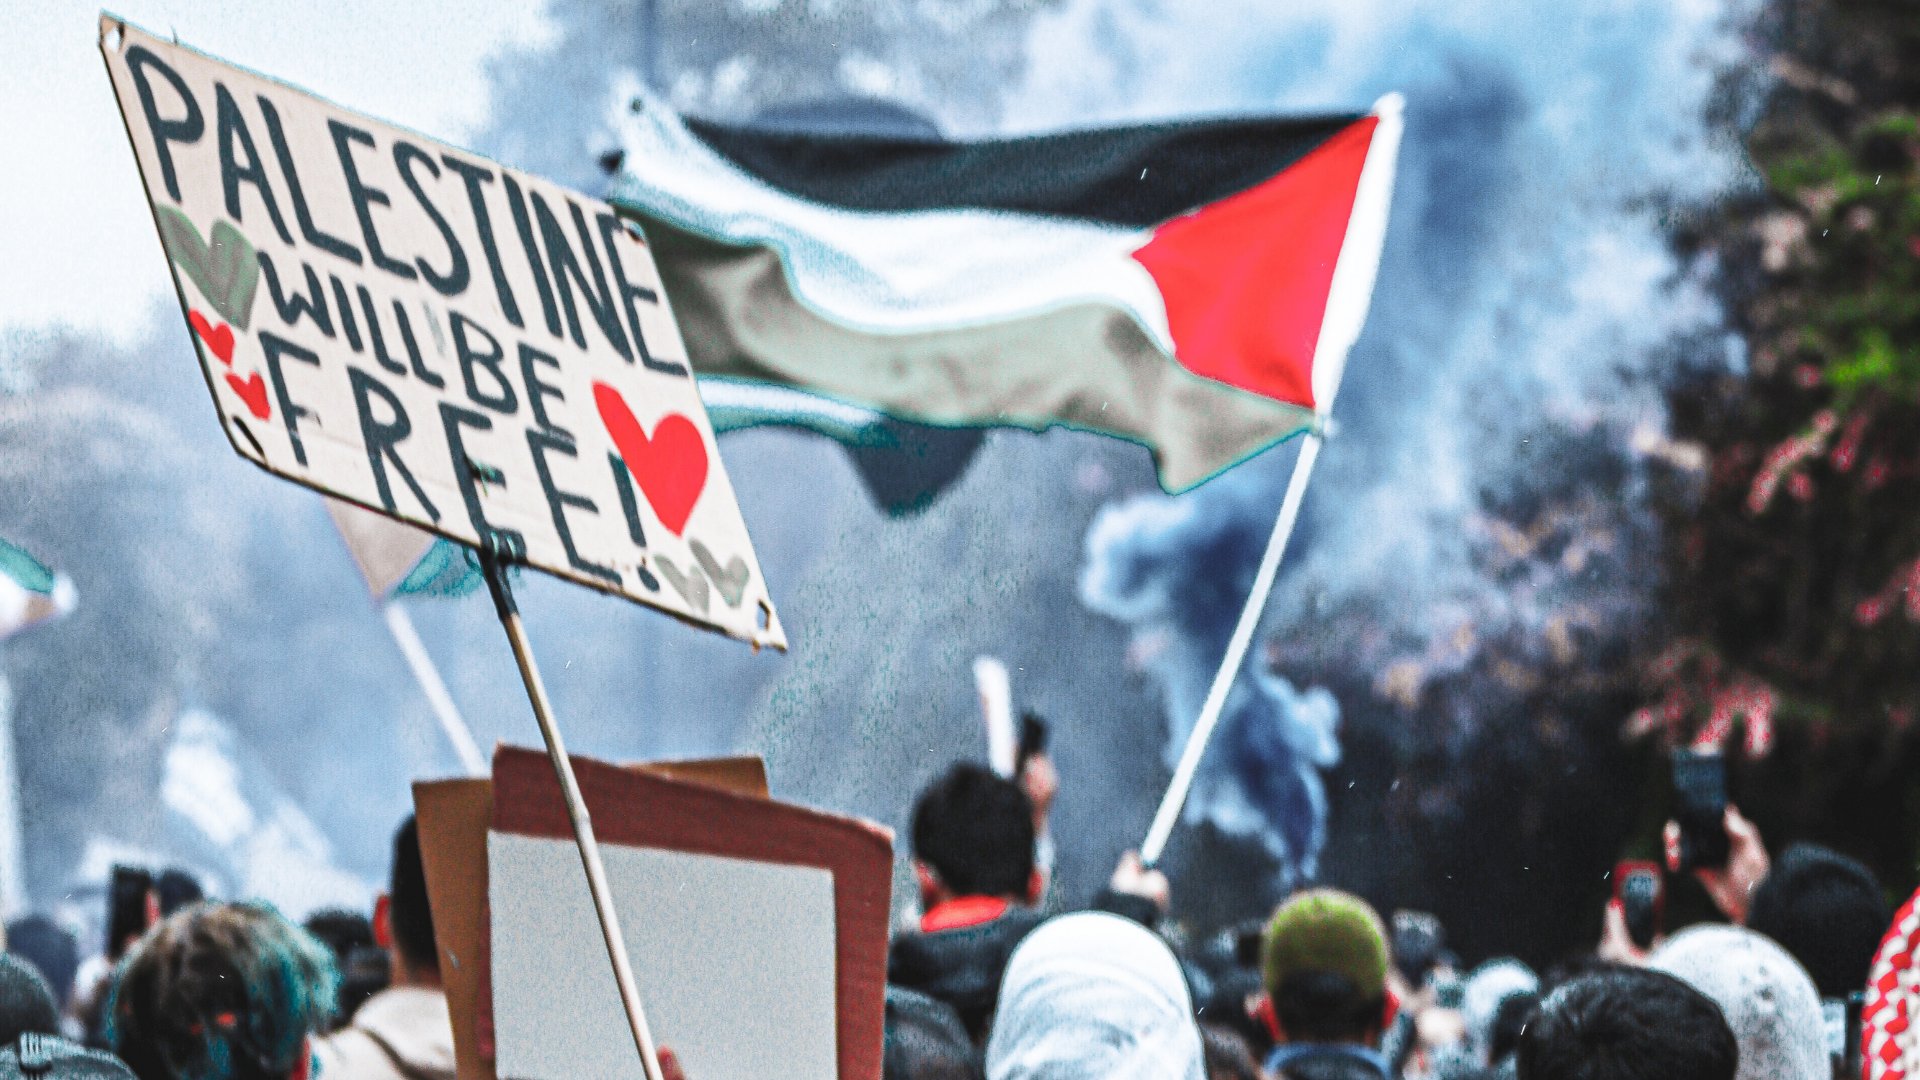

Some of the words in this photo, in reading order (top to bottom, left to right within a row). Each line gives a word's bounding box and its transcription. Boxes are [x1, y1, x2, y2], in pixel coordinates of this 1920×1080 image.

[125, 45, 689, 377] PALESTINE
[257, 250, 445, 389] WILL
[449, 310, 576, 443] BE
[258, 331, 661, 592] FREE!
